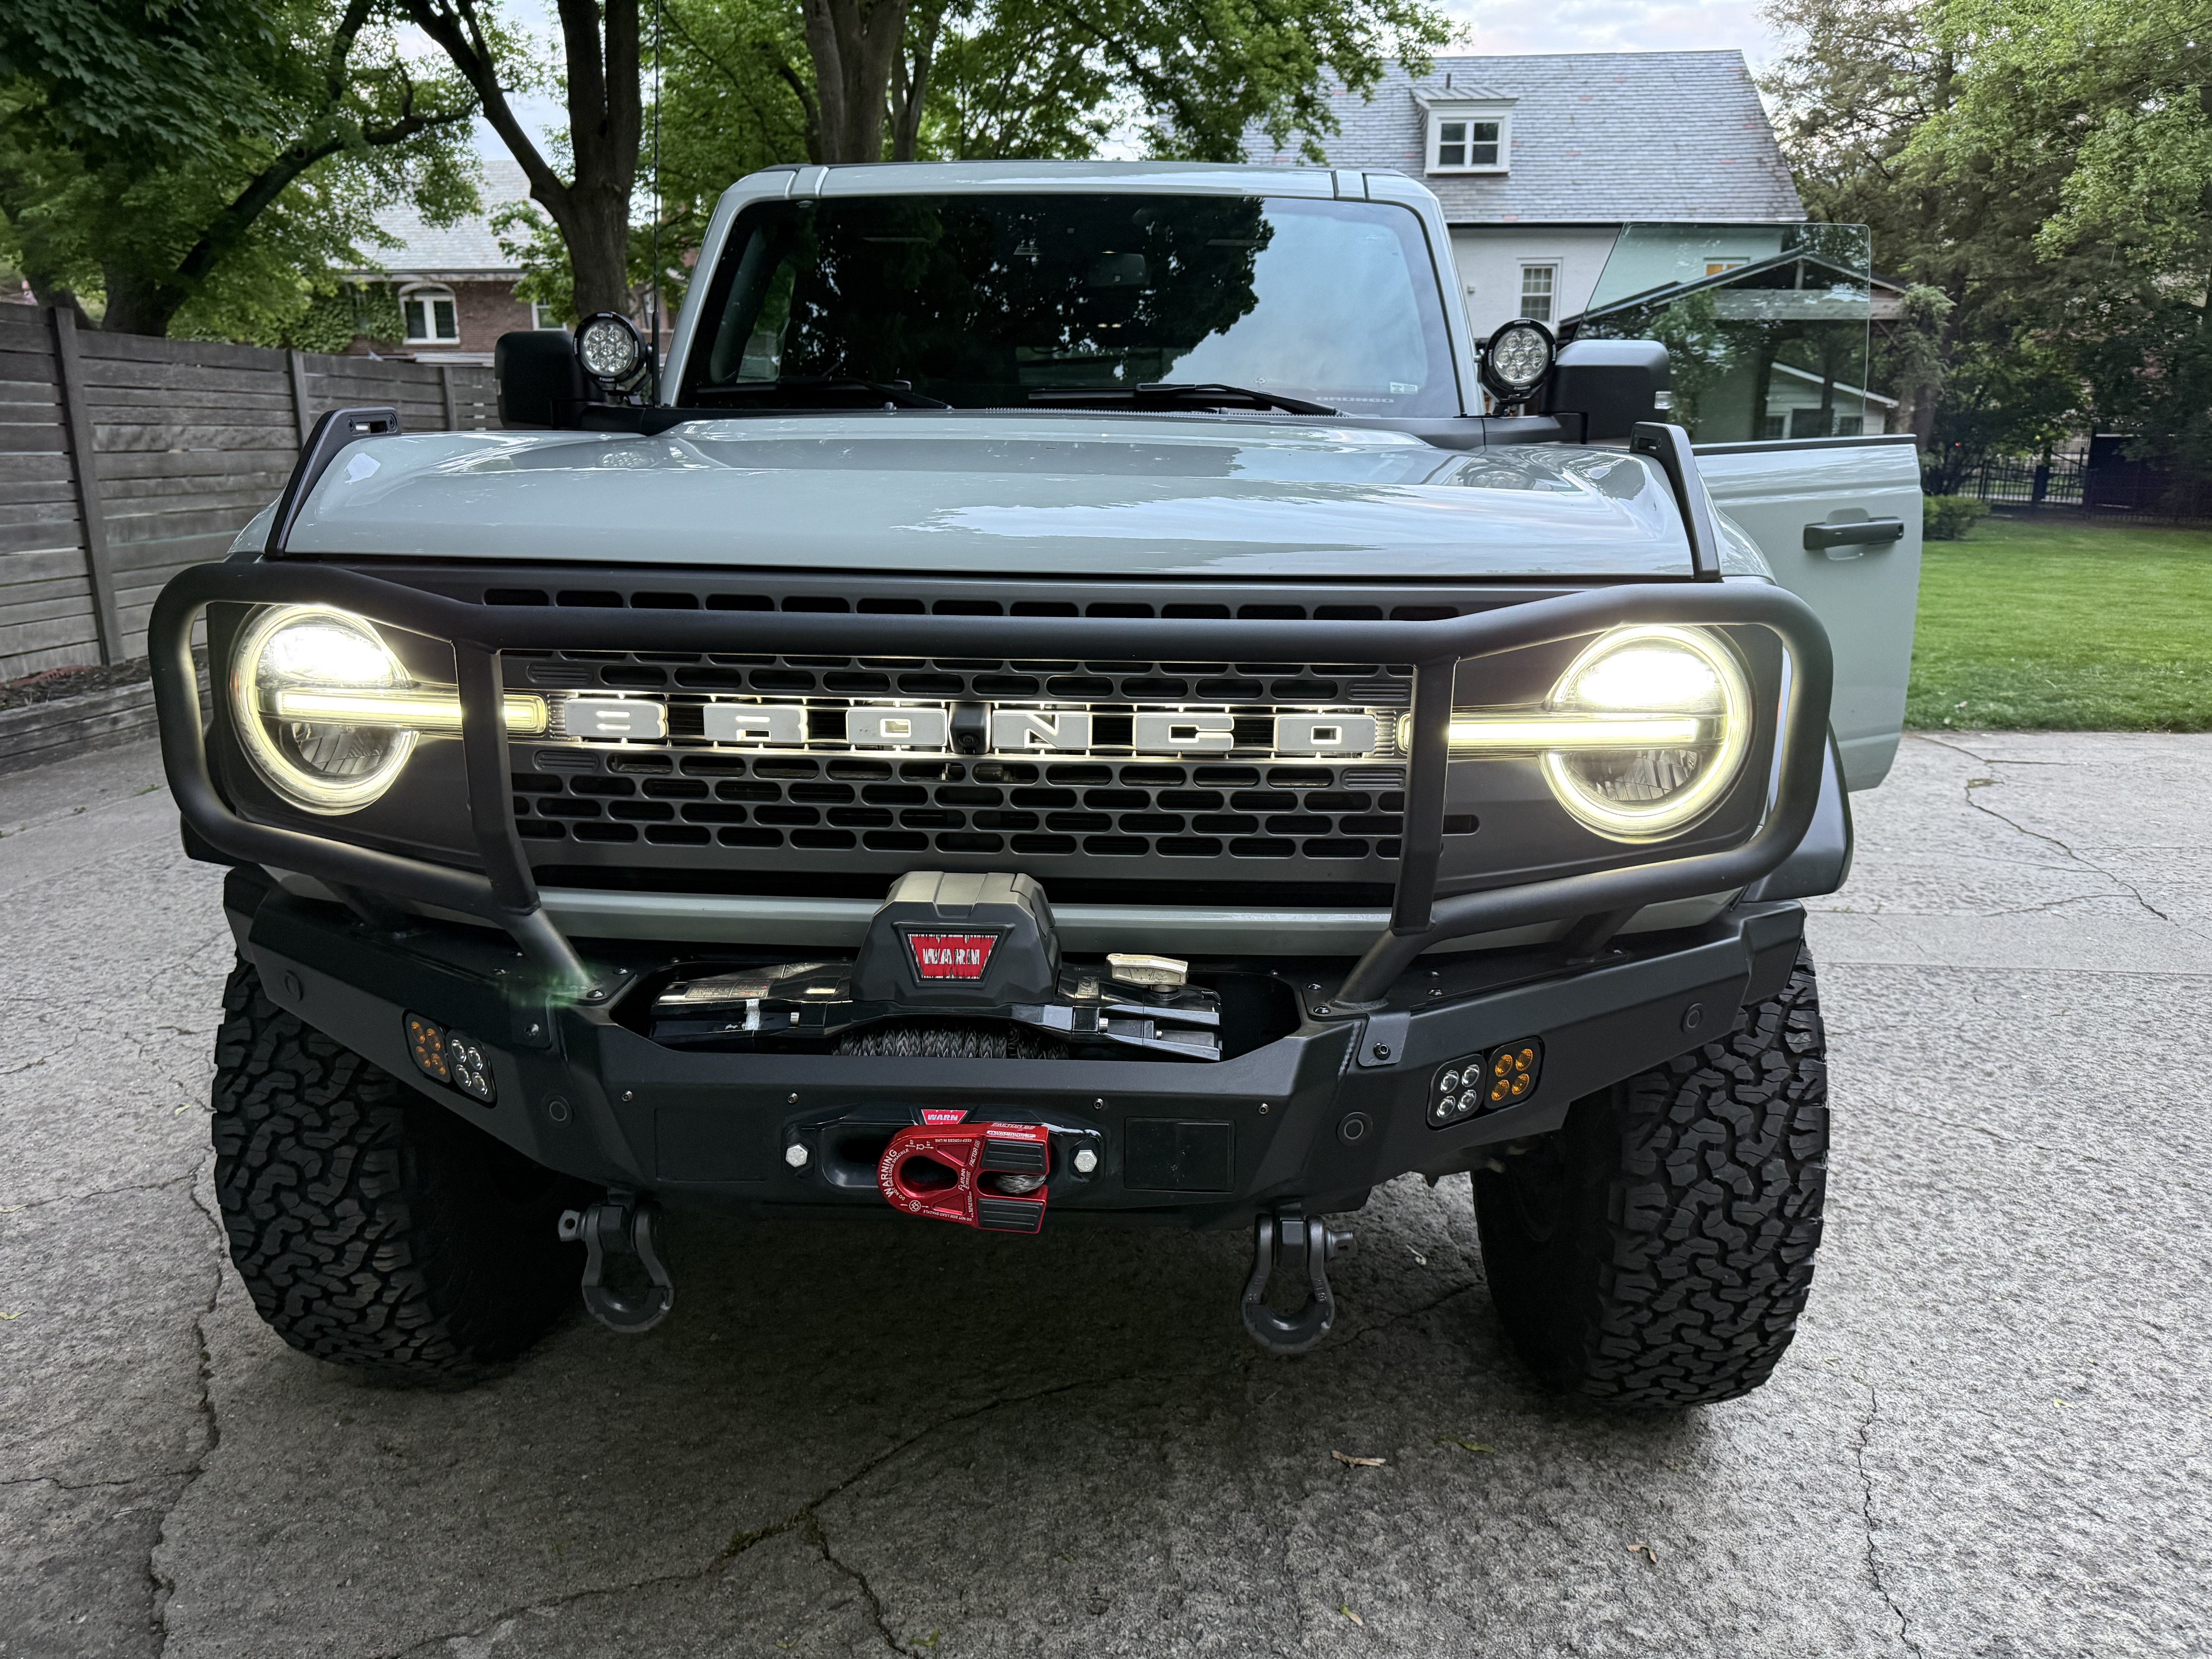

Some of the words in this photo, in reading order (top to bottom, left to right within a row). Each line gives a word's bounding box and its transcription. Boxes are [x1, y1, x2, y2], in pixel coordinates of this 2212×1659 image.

[564, 699, 1376, 752] BRONCO
[922, 948, 980, 965] WARN
[893, 1148, 909, 1164] SHACKLE
[969, 1148, 978, 1167] FACTOR
[881, 1149, 897, 1197] WARNING
[891, 1187, 900, 1196] NOT
